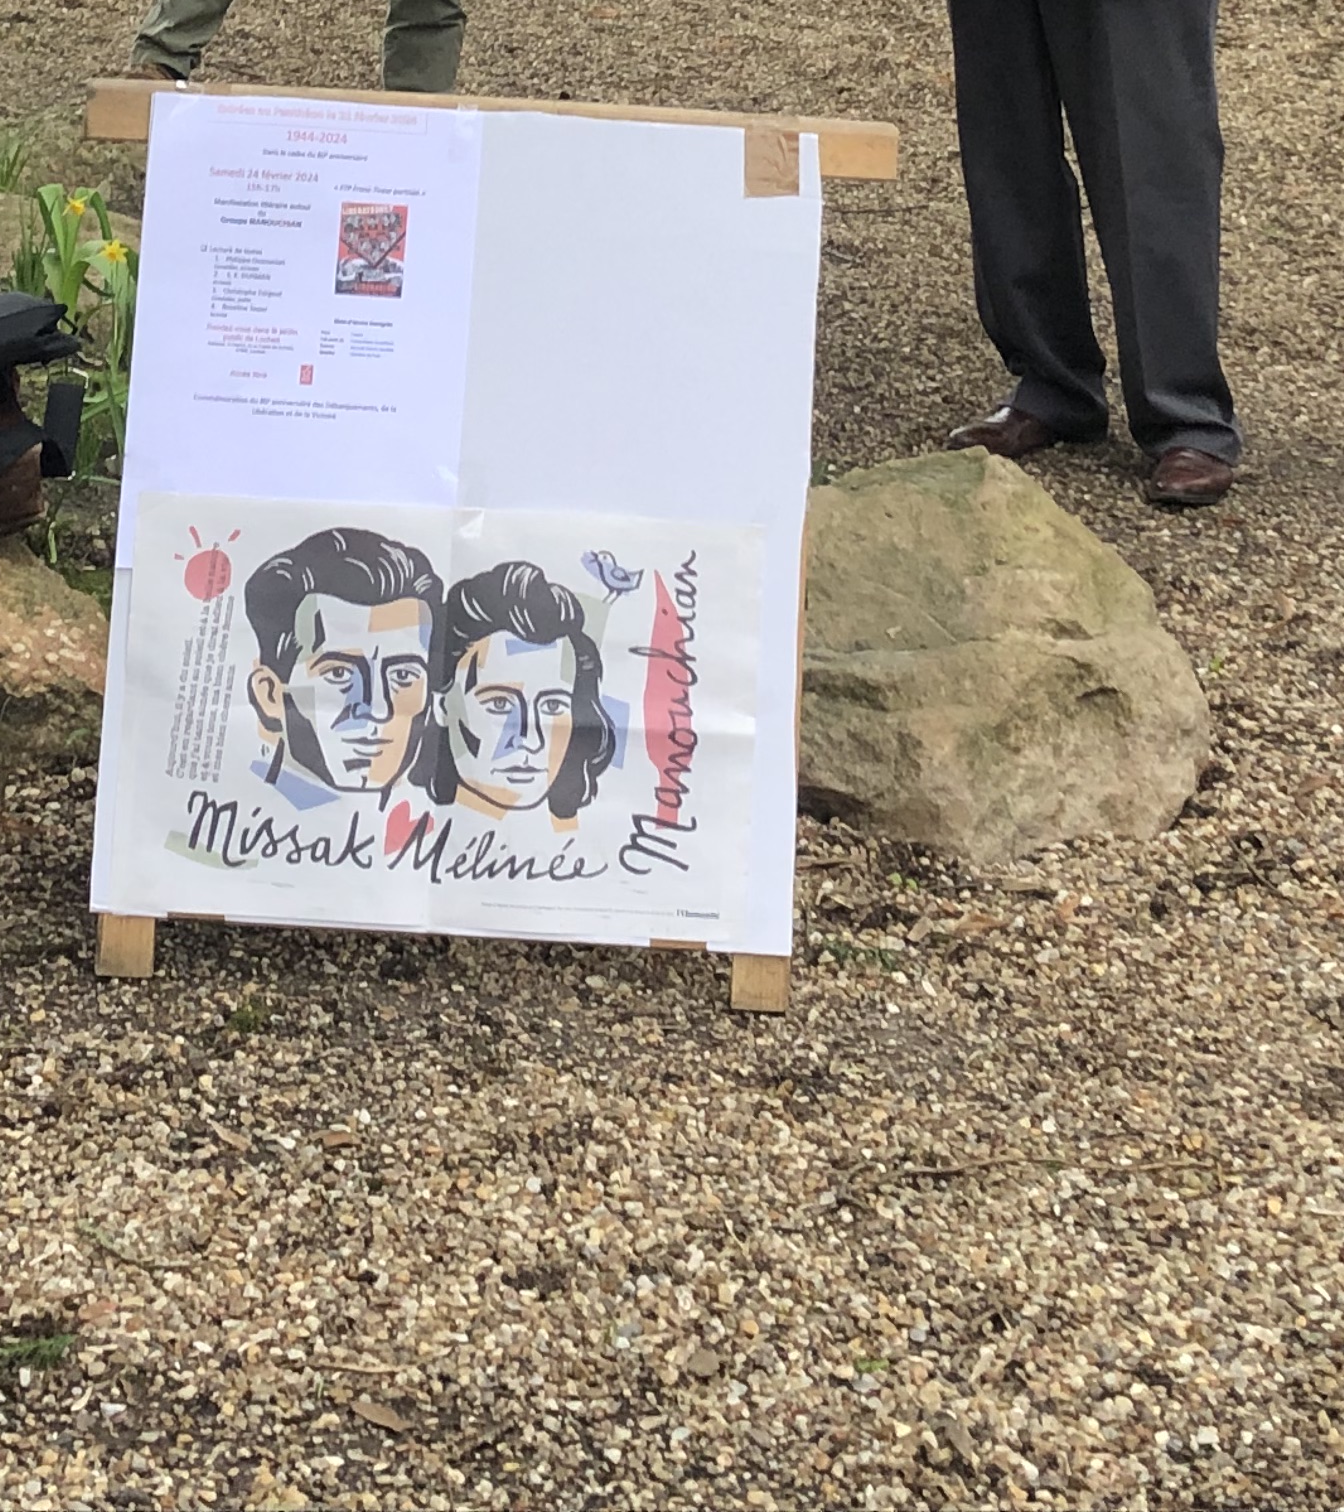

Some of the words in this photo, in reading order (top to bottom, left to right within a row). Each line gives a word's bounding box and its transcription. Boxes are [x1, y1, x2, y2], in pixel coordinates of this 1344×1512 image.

[287, 129, 348, 144] 1944-2024
[209, 165, 245, 178] Samedi
[247, 169, 259, 179] 24
[261, 169, 293, 181] février
[295, 171, 319, 183] 2024
[619, 549, 698, 875] Manouchian
[188, 791, 375, 869] Missak
[388, 810, 608, 884] Mélinée
